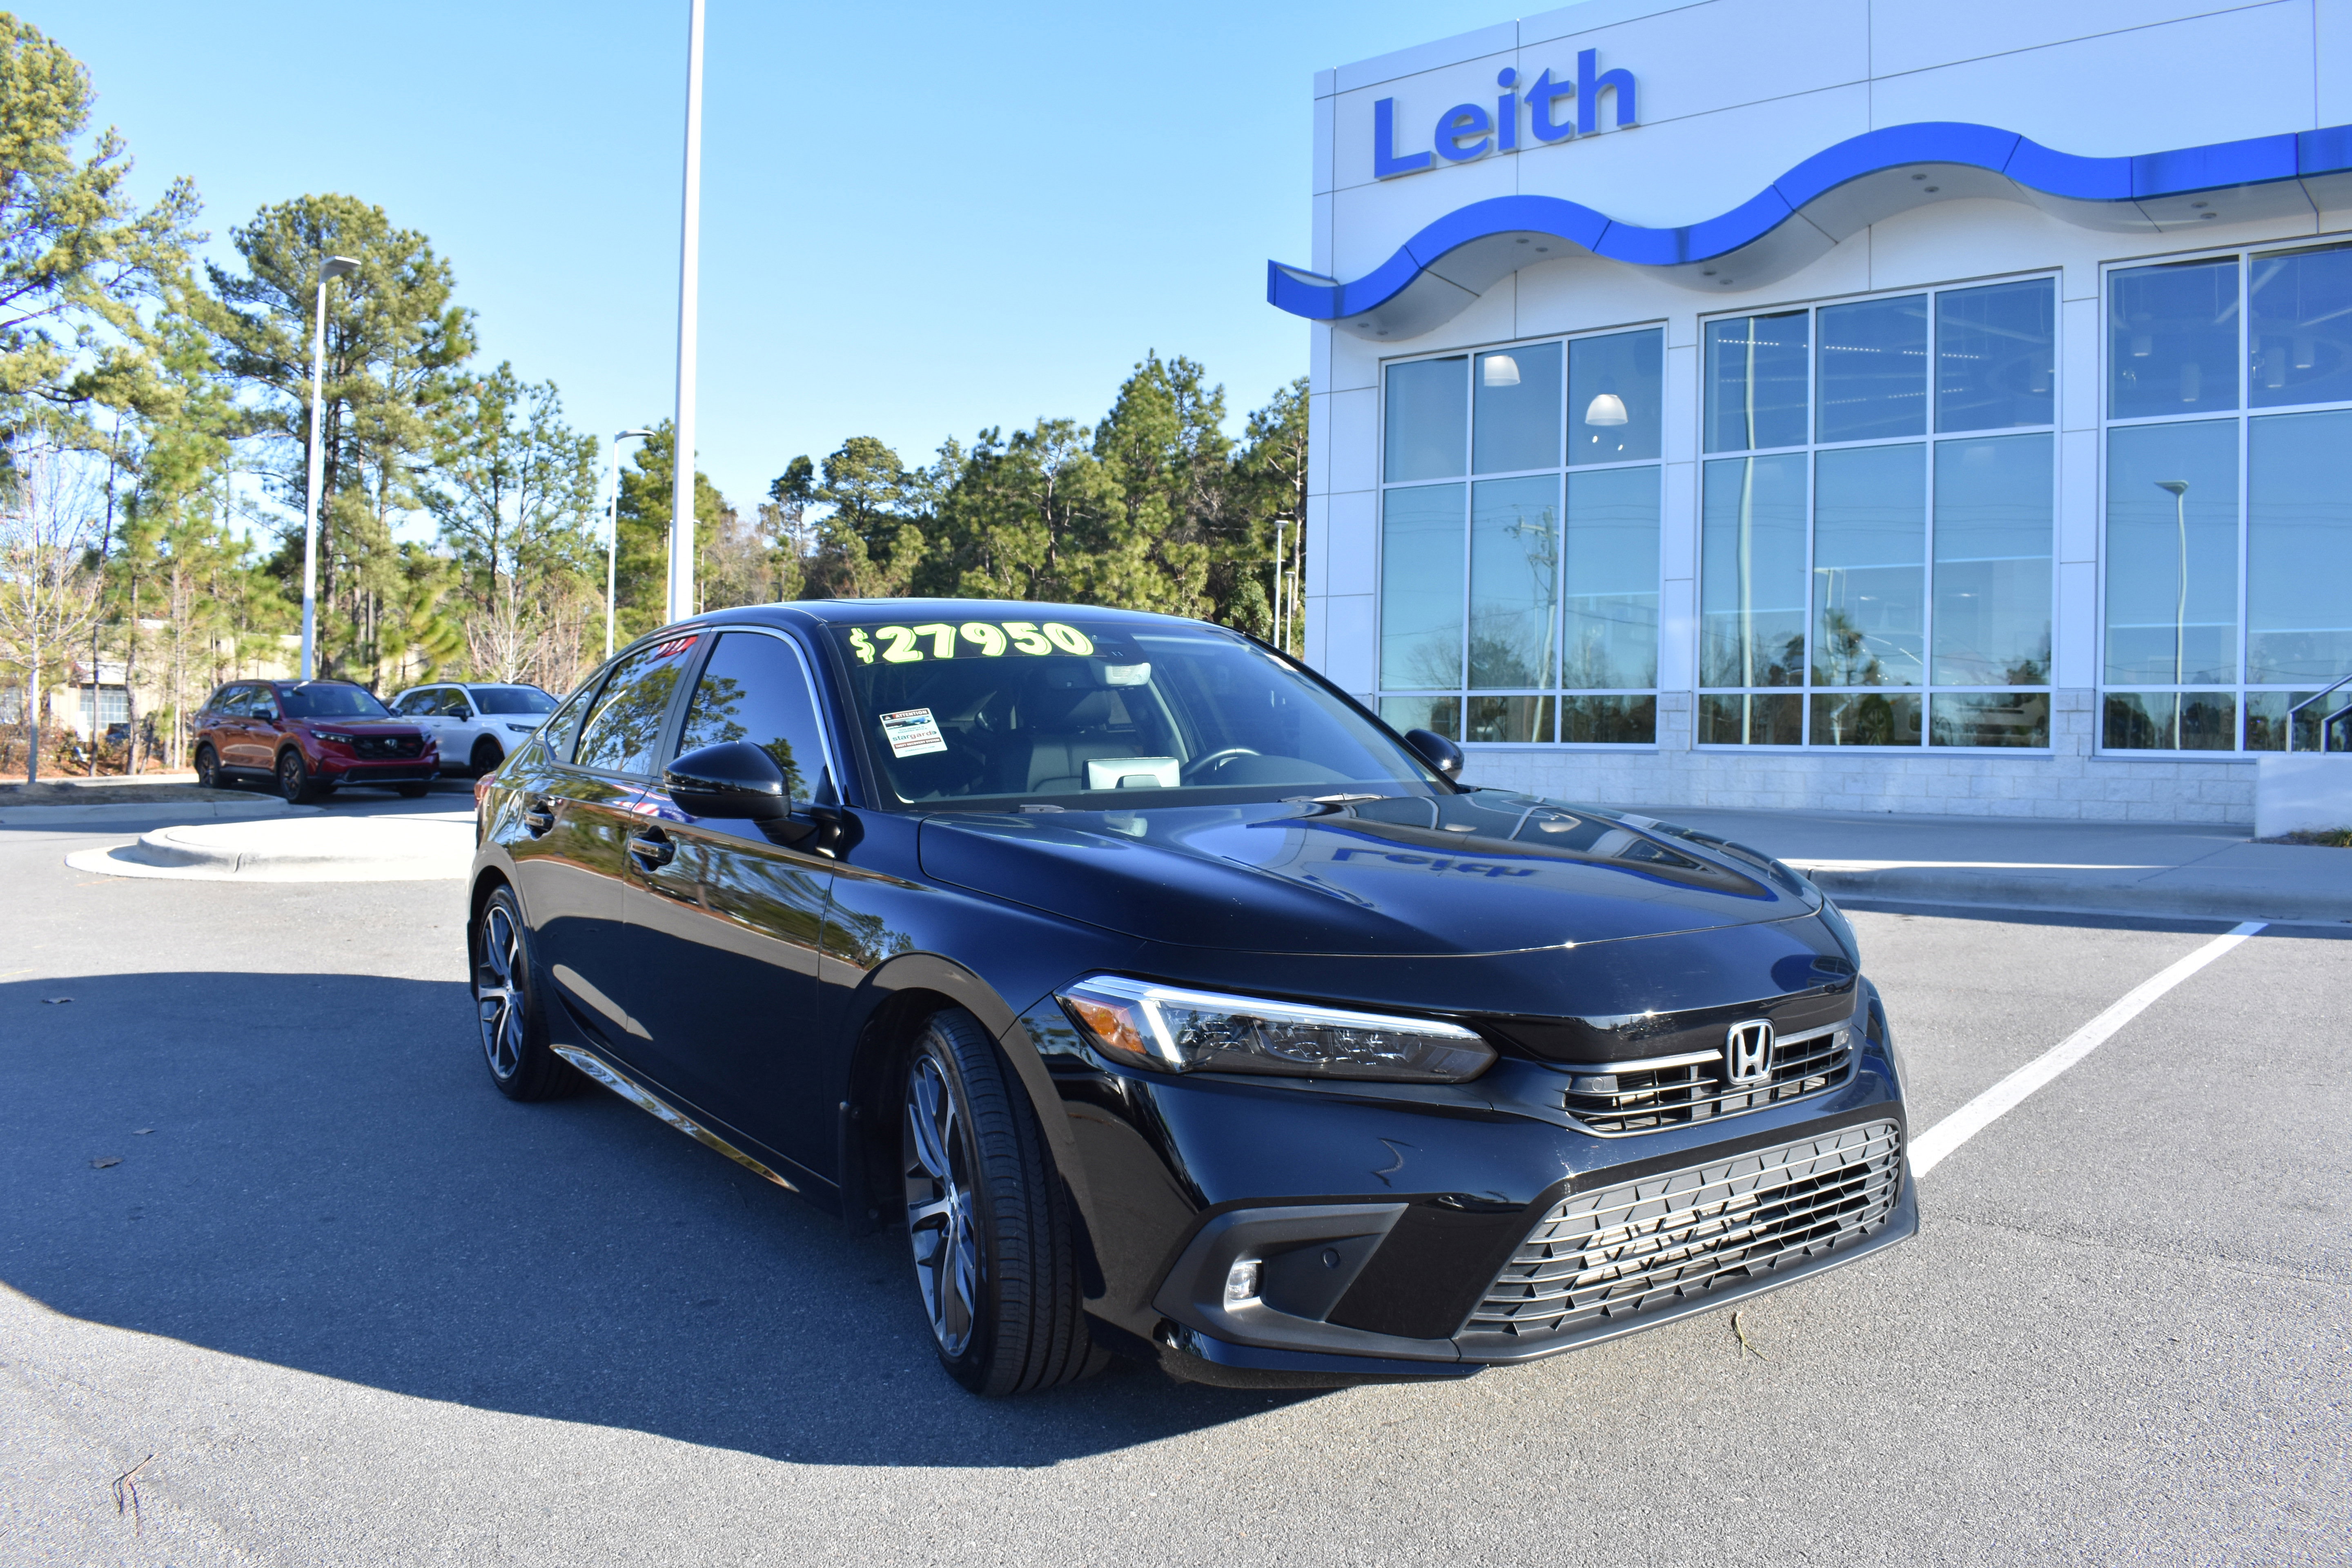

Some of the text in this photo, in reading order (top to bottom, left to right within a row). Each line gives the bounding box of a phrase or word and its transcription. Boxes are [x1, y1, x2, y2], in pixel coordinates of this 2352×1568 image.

[1374, 48, 1641, 180] Leith
[850, 622, 1094, 664] $27950
[895, 710, 927, 718] ATTENTION
[893, 731, 932, 741] stargard
